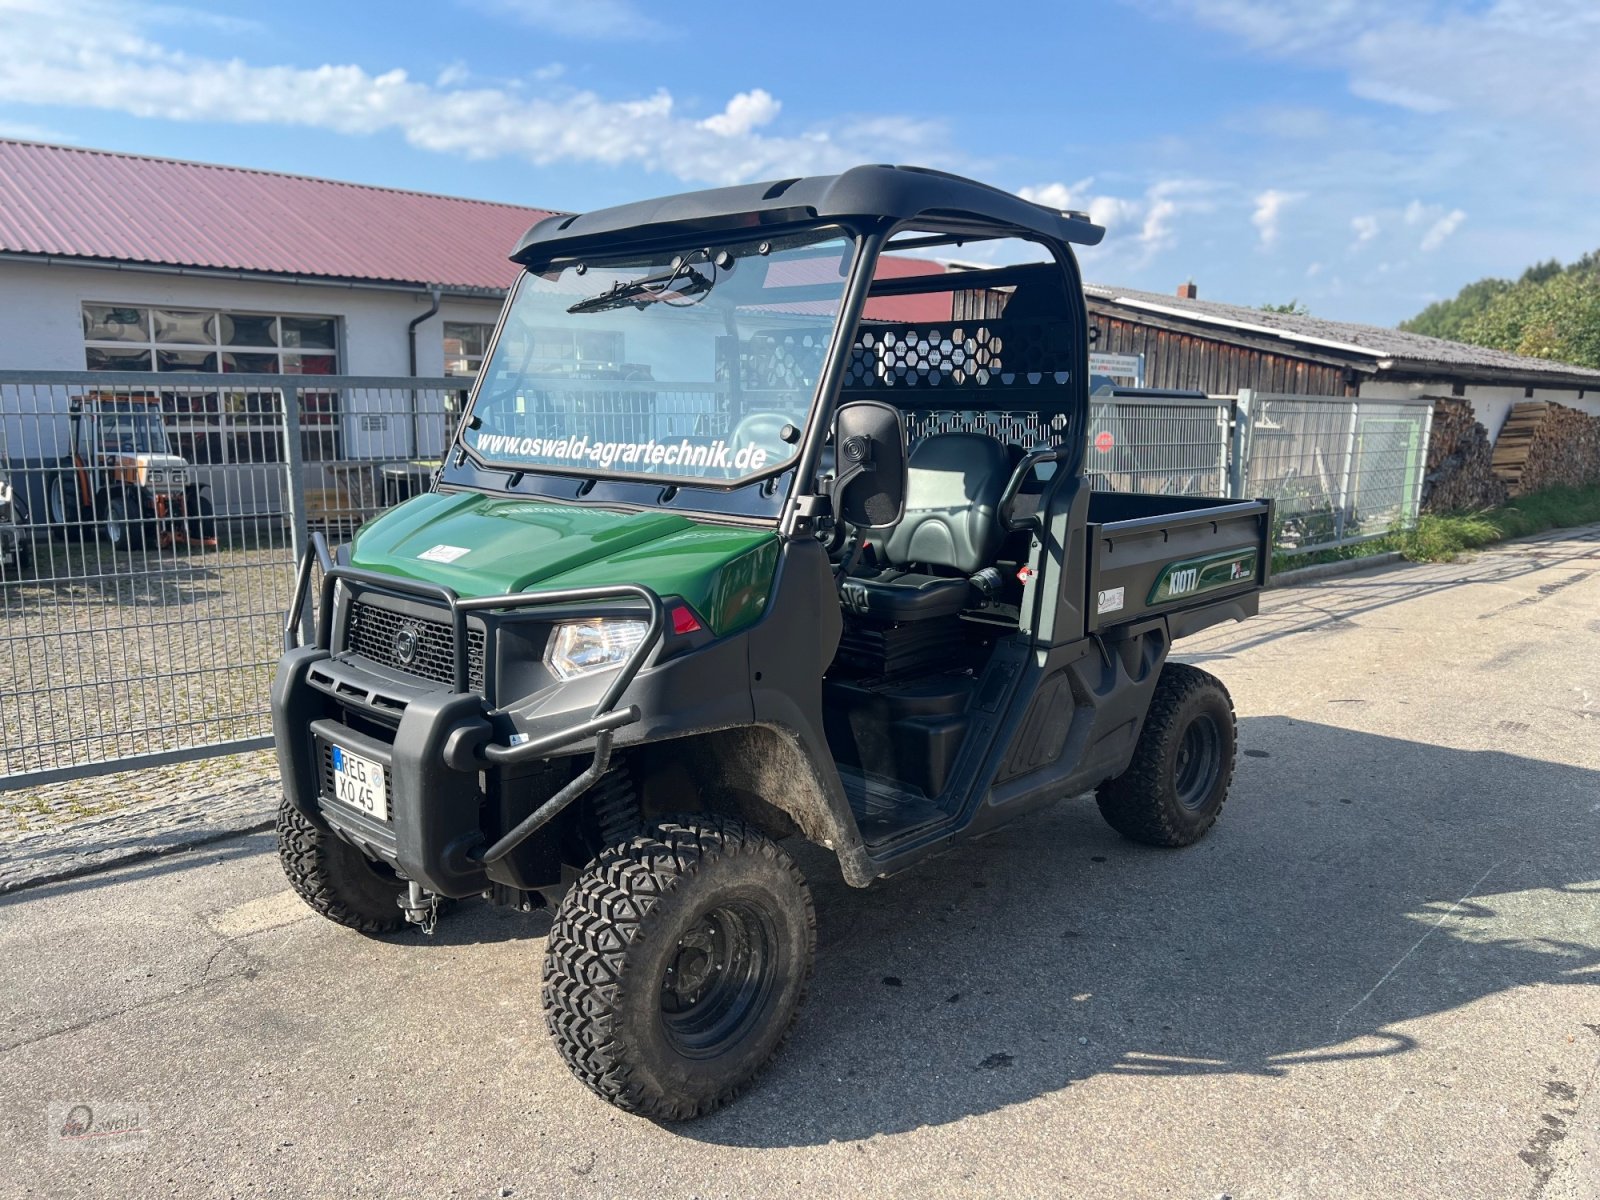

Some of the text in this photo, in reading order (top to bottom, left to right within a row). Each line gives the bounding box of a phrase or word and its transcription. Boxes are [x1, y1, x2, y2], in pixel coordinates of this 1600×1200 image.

[476, 433, 767, 470] www.oswald-agrartechnik.de
[1168, 568, 1198, 596] KIOTI
[341, 754, 367, 784] REG
[358, 786, 374, 811] 45
